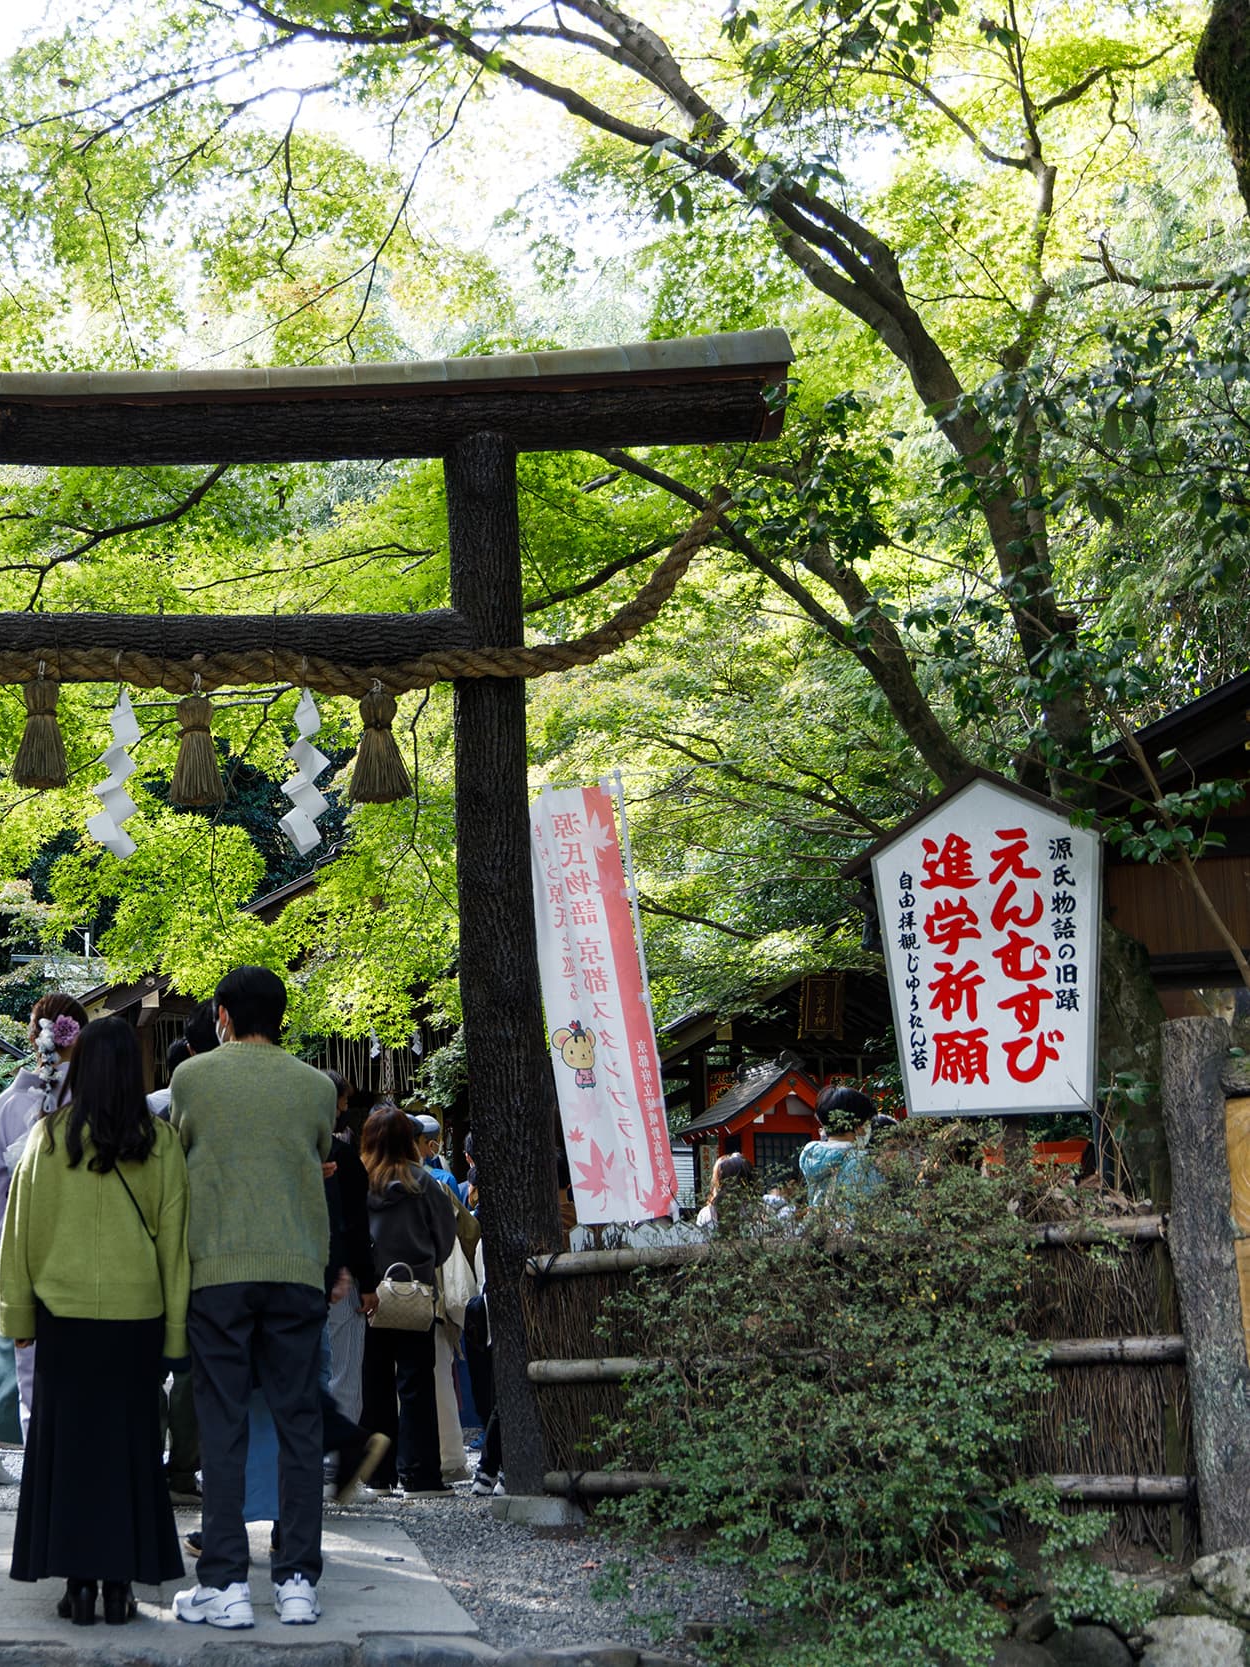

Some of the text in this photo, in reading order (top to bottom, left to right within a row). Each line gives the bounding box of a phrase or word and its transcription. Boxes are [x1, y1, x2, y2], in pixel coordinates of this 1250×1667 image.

[919, 832, 990, 1086] 進学祈願
[988, 827, 1065, 1083] えんむすび
[1048, 837, 1080, 1012] 源氏物語の旧蹟
